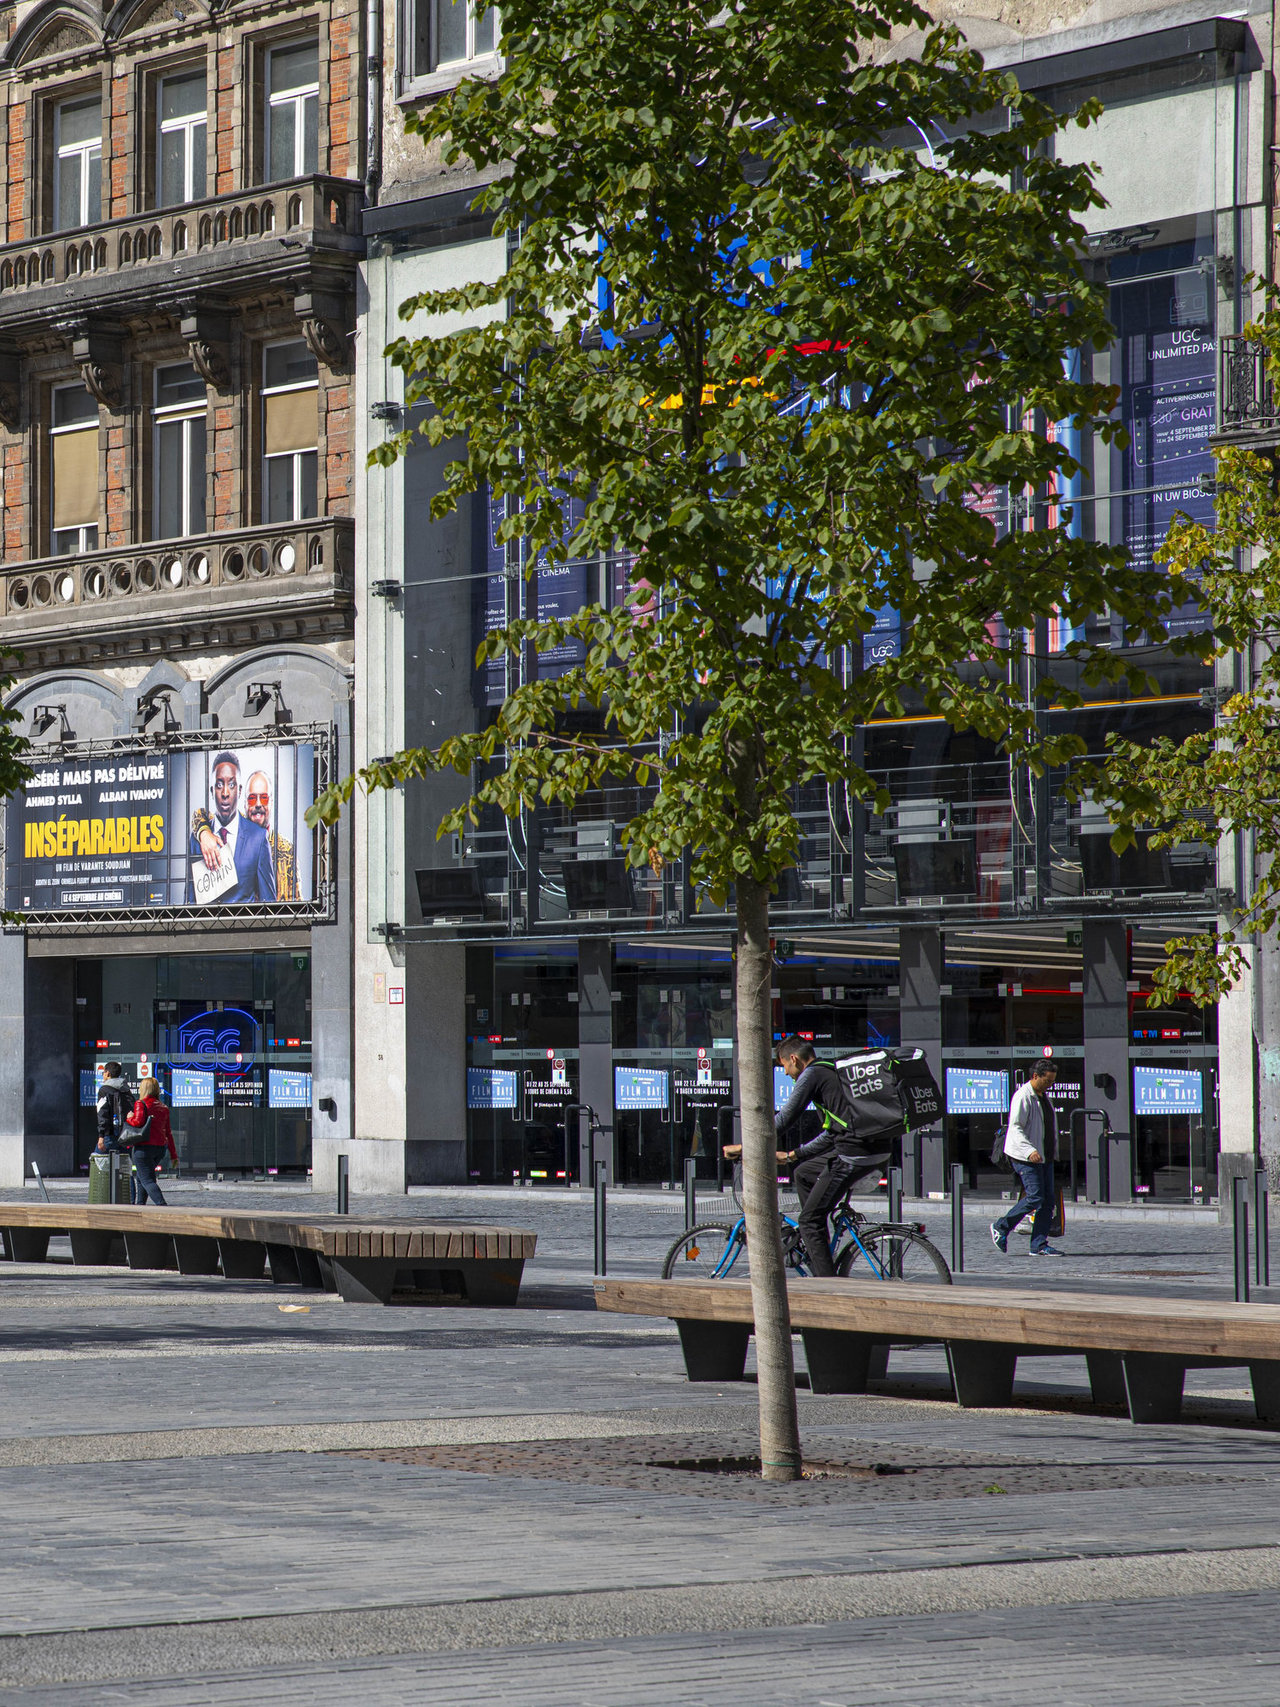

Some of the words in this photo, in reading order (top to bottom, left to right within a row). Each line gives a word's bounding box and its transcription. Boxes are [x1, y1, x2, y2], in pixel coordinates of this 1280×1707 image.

[1172, 328, 1200, 344] UGC
[1148, 344, 1200, 360] UNLIMITED
[1175, 425, 1208, 434] SEPTEMBER
[1175, 432, 1208, 441] SEPTEMBER
[1153, 494, 1162, 502] IN
[1165, 490, 1180, 501] UW
[872, 646, 892, 658] UGC
[63, 770, 91, 786] MAIS
[94, 768, 116, 784] PAS
[119, 762, 164, 782] DÉLIVRÉ
[26, 796, 55, 807] AHMED
[58, 794, 82, 805] SYLLA
[99, 791, 127, 802] ALBAN
[130, 789, 164, 801] IVANOV
[24, 814, 164, 858] INSÉPARABLES
[56, 864, 62, 872] UN
[63, 863, 73, 872] FILM
[74, 862, 80, 871] DE
[81, 862, 104, 870] VARANTE
[197, 858, 232, 893] COPAIN
[165, 1028, 241, 1070] UGC
[846, 1064, 882, 1081] Uber
[176, 1085, 192, 1095] FILM
[197, 1086, 211, 1095] DAYS
[273, 1086, 289, 1096] FILM
[296, 1086, 310, 1096] DAYS
[472, 1086, 491, 1096] FILM
[497, 1086, 512, 1096] DAYS
[621, 1086, 640, 1096] FILM
[647, 1086, 664, 1096] DAYS
[850, 1079, 883, 1098] Eats
[910, 1086, 933, 1099] Uber
[953, 1088, 976, 1099] FILM
[984, 1088, 1004, 1099] DAYS
[1142, 1088, 1166, 1100] FILM
[1175, 1088, 1197, 1100] DAYS
[914, 1100, 938, 1113] Eats
